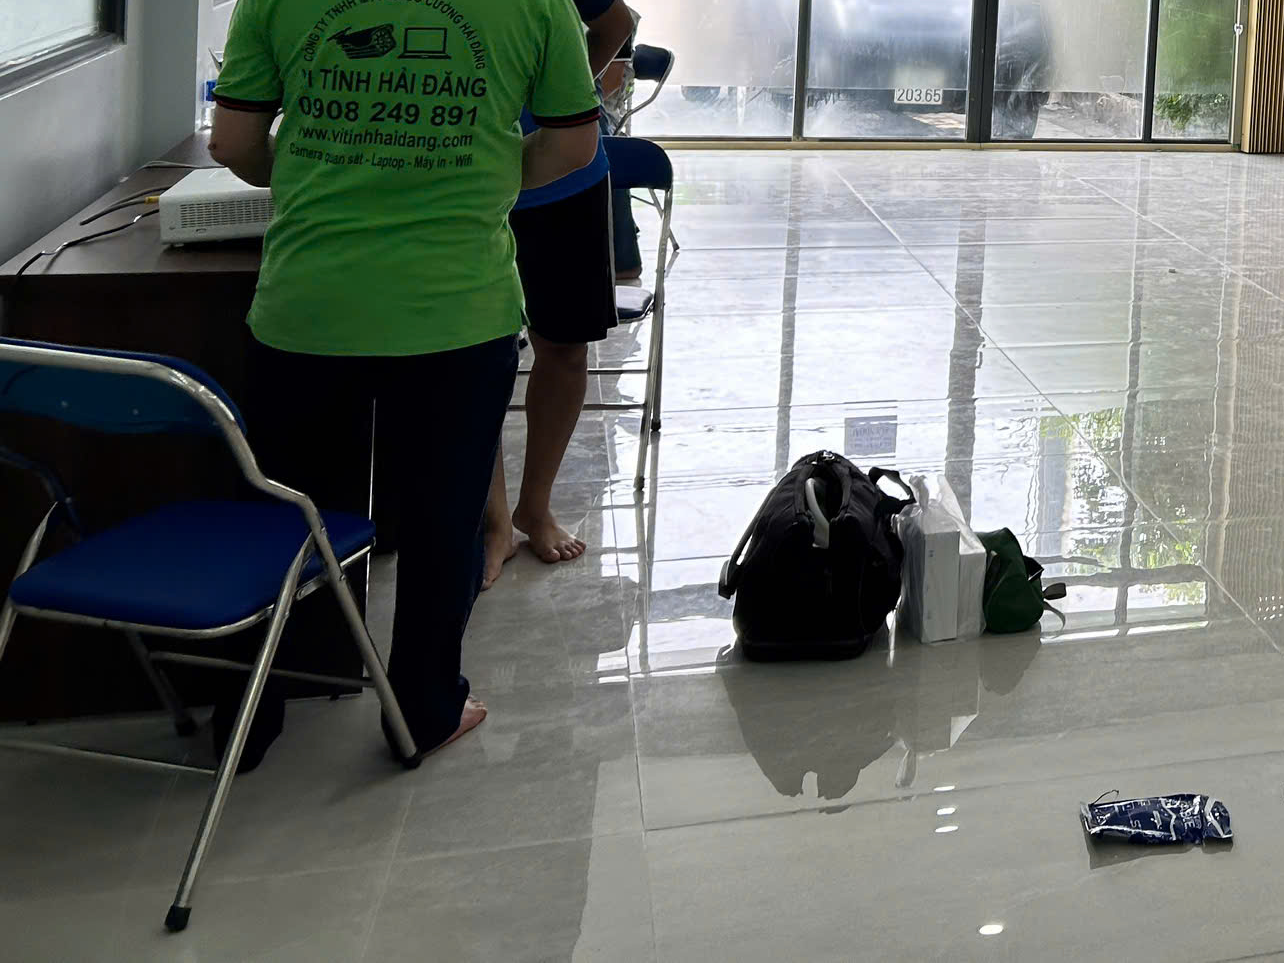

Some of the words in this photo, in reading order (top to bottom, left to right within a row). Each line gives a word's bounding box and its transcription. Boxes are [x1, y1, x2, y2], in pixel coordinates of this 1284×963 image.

[313, 18, 328, 33] TY
[320, 64, 371, 93] TÍNH
[379, 67, 417, 94] HẢI
[422, 71, 488, 97] ĐĂNG
[299, 95, 360, 123] 0908
[368, 101, 420, 125] 249
[430, 105, 479, 127] 891
[289, 142, 324, 161] Camera
[371, 153, 405, 172] Laptop
[413, 155, 435, 171] Máy
[455, 153, 473, 168] Wifi
